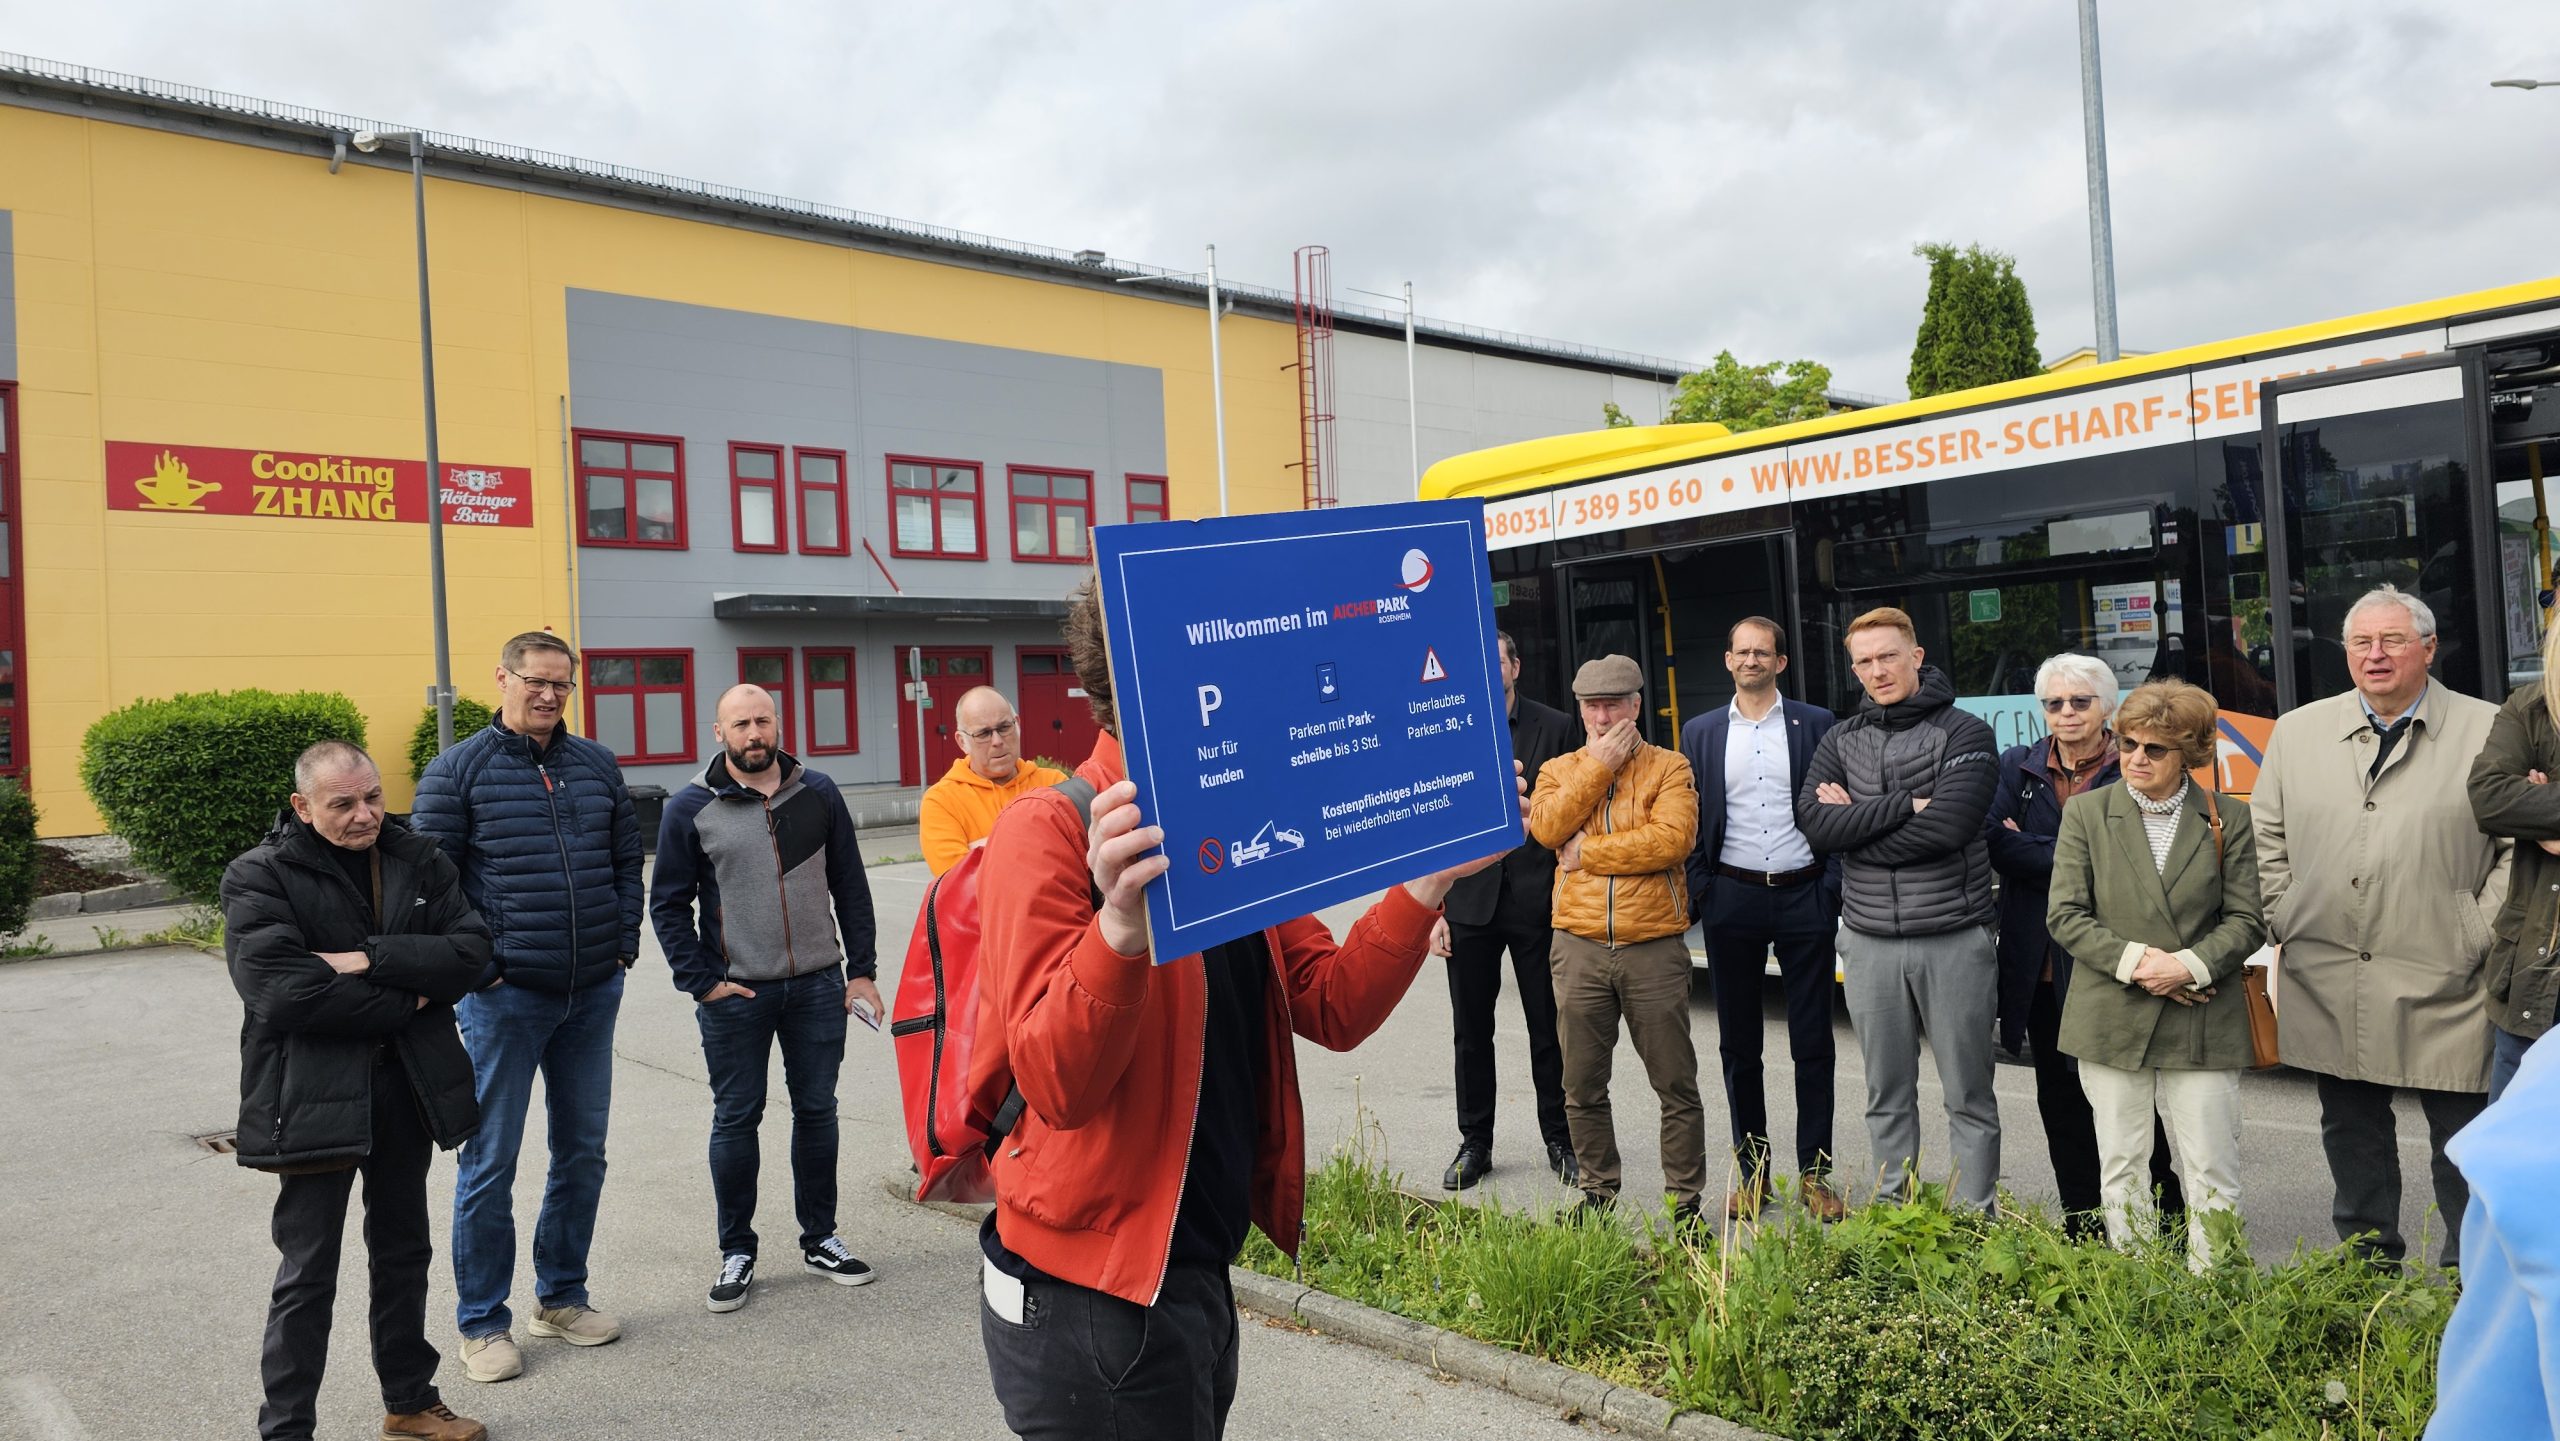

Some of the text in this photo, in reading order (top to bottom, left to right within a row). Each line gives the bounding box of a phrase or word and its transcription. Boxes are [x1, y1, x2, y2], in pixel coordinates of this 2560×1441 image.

[251, 453, 395, 493] Cooking
[252, 486, 396, 520] ZHANG
[439, 488, 517, 510] Flötzinger
[452, 506, 500, 524] Bräu
[1575, 494, 1620, 525] 389
[1628, 486, 1660, 516] 50
[1669, 478, 1703, 507] 60
[1185, 595, 1410, 646] Willkommen im AICHERPARK
[1378, 612, 1412, 624] ROSENHEIM
[1197, 683, 1223, 727] P
[1408, 693, 1466, 715] Unerlaubtes
[1289, 710, 1376, 740] Parken mit Park-
[1445, 717, 1465, 732] 30,-
[1466, 713, 1474, 727] €
[1197, 739, 1239, 761] Nur für
[1290, 733, 1382, 767] scheibe bis 3 Std.
[1199, 767, 1245, 789] Kunden
[1321, 770, 1475, 820] Kostenpflichtiges Abschleppen
[1325, 793, 1454, 841] bei wiederholtem Verstoß.
